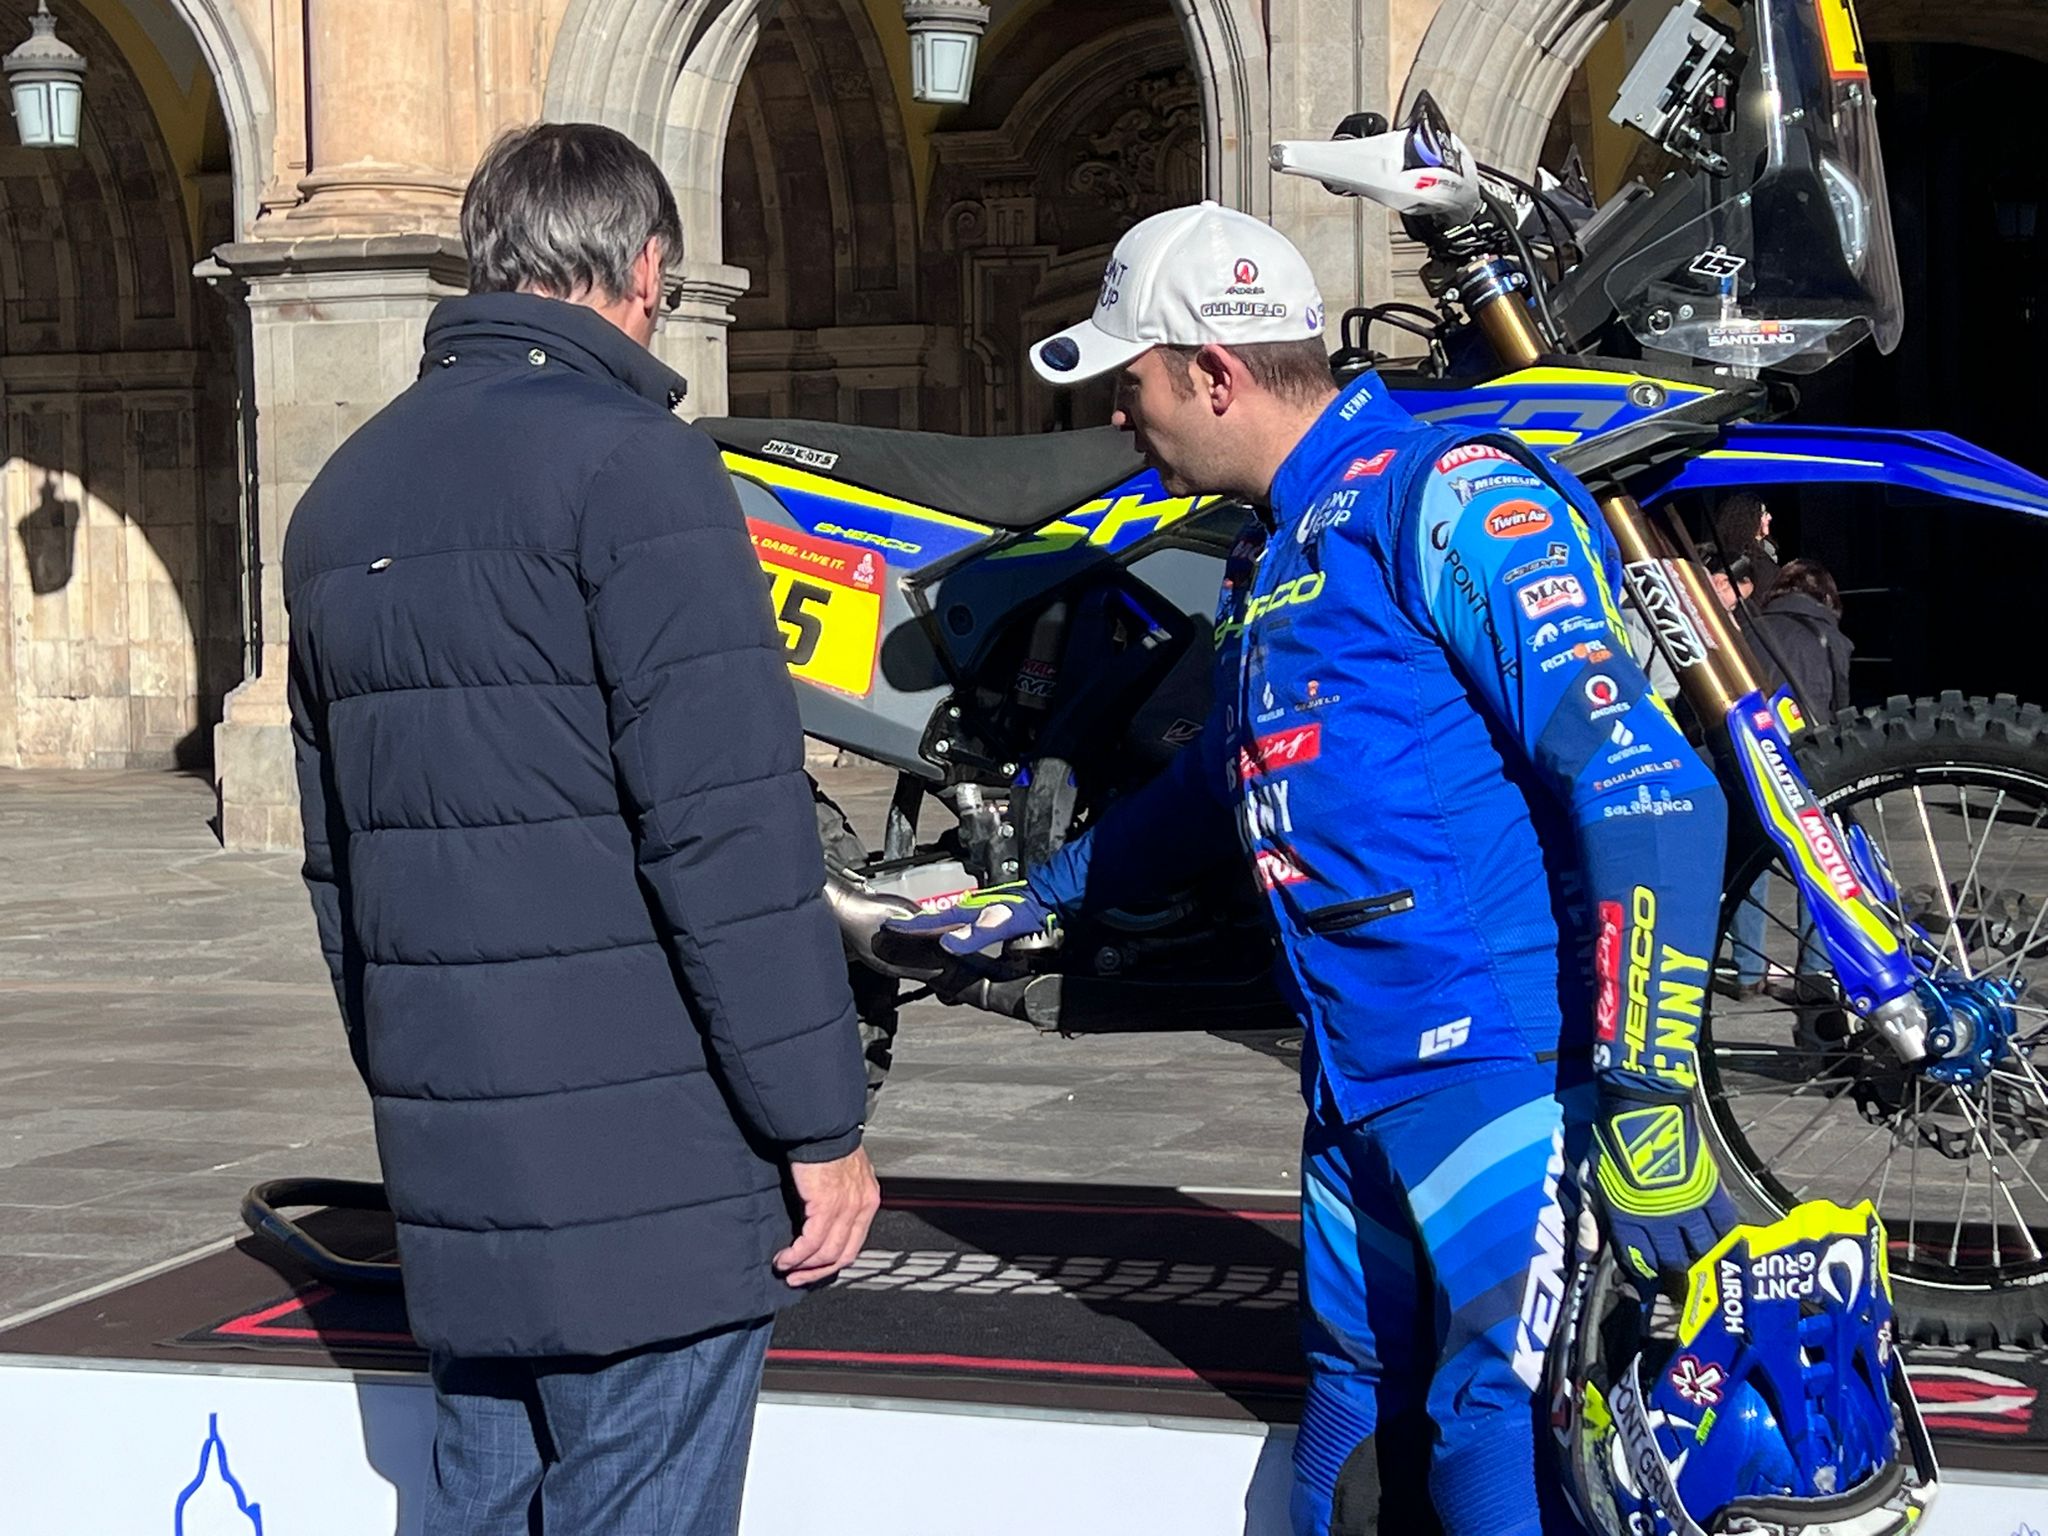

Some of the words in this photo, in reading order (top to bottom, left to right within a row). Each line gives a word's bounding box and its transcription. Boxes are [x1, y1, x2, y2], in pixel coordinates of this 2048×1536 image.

[1200, 302, 1287, 318] GUIJUELO
[1708, 332, 1795, 347] SANTOLINO
[1339, 387, 1373, 421] KENNY
[1474, 475, 1541, 491] MICHELIN
[1490, 511, 1526, 533] Twin
[1528, 509, 1548, 523] Air
[813, 521, 923, 555] SHERCO
[800, 549, 829, 566] LIVE
[1444, 548, 1489, 616] PONT
[1524, 579, 1579, 607] MAC
[1803, 812, 1862, 898] MOTUL
[920, 895, 966, 915] MOT
[1622, 884, 1657, 1074] HERCO
[1653, 944, 1710, 1088] ENNY
[1751, 1250, 1817, 1278] GRUP
[1720, 1259, 1744, 1334] AIROH
